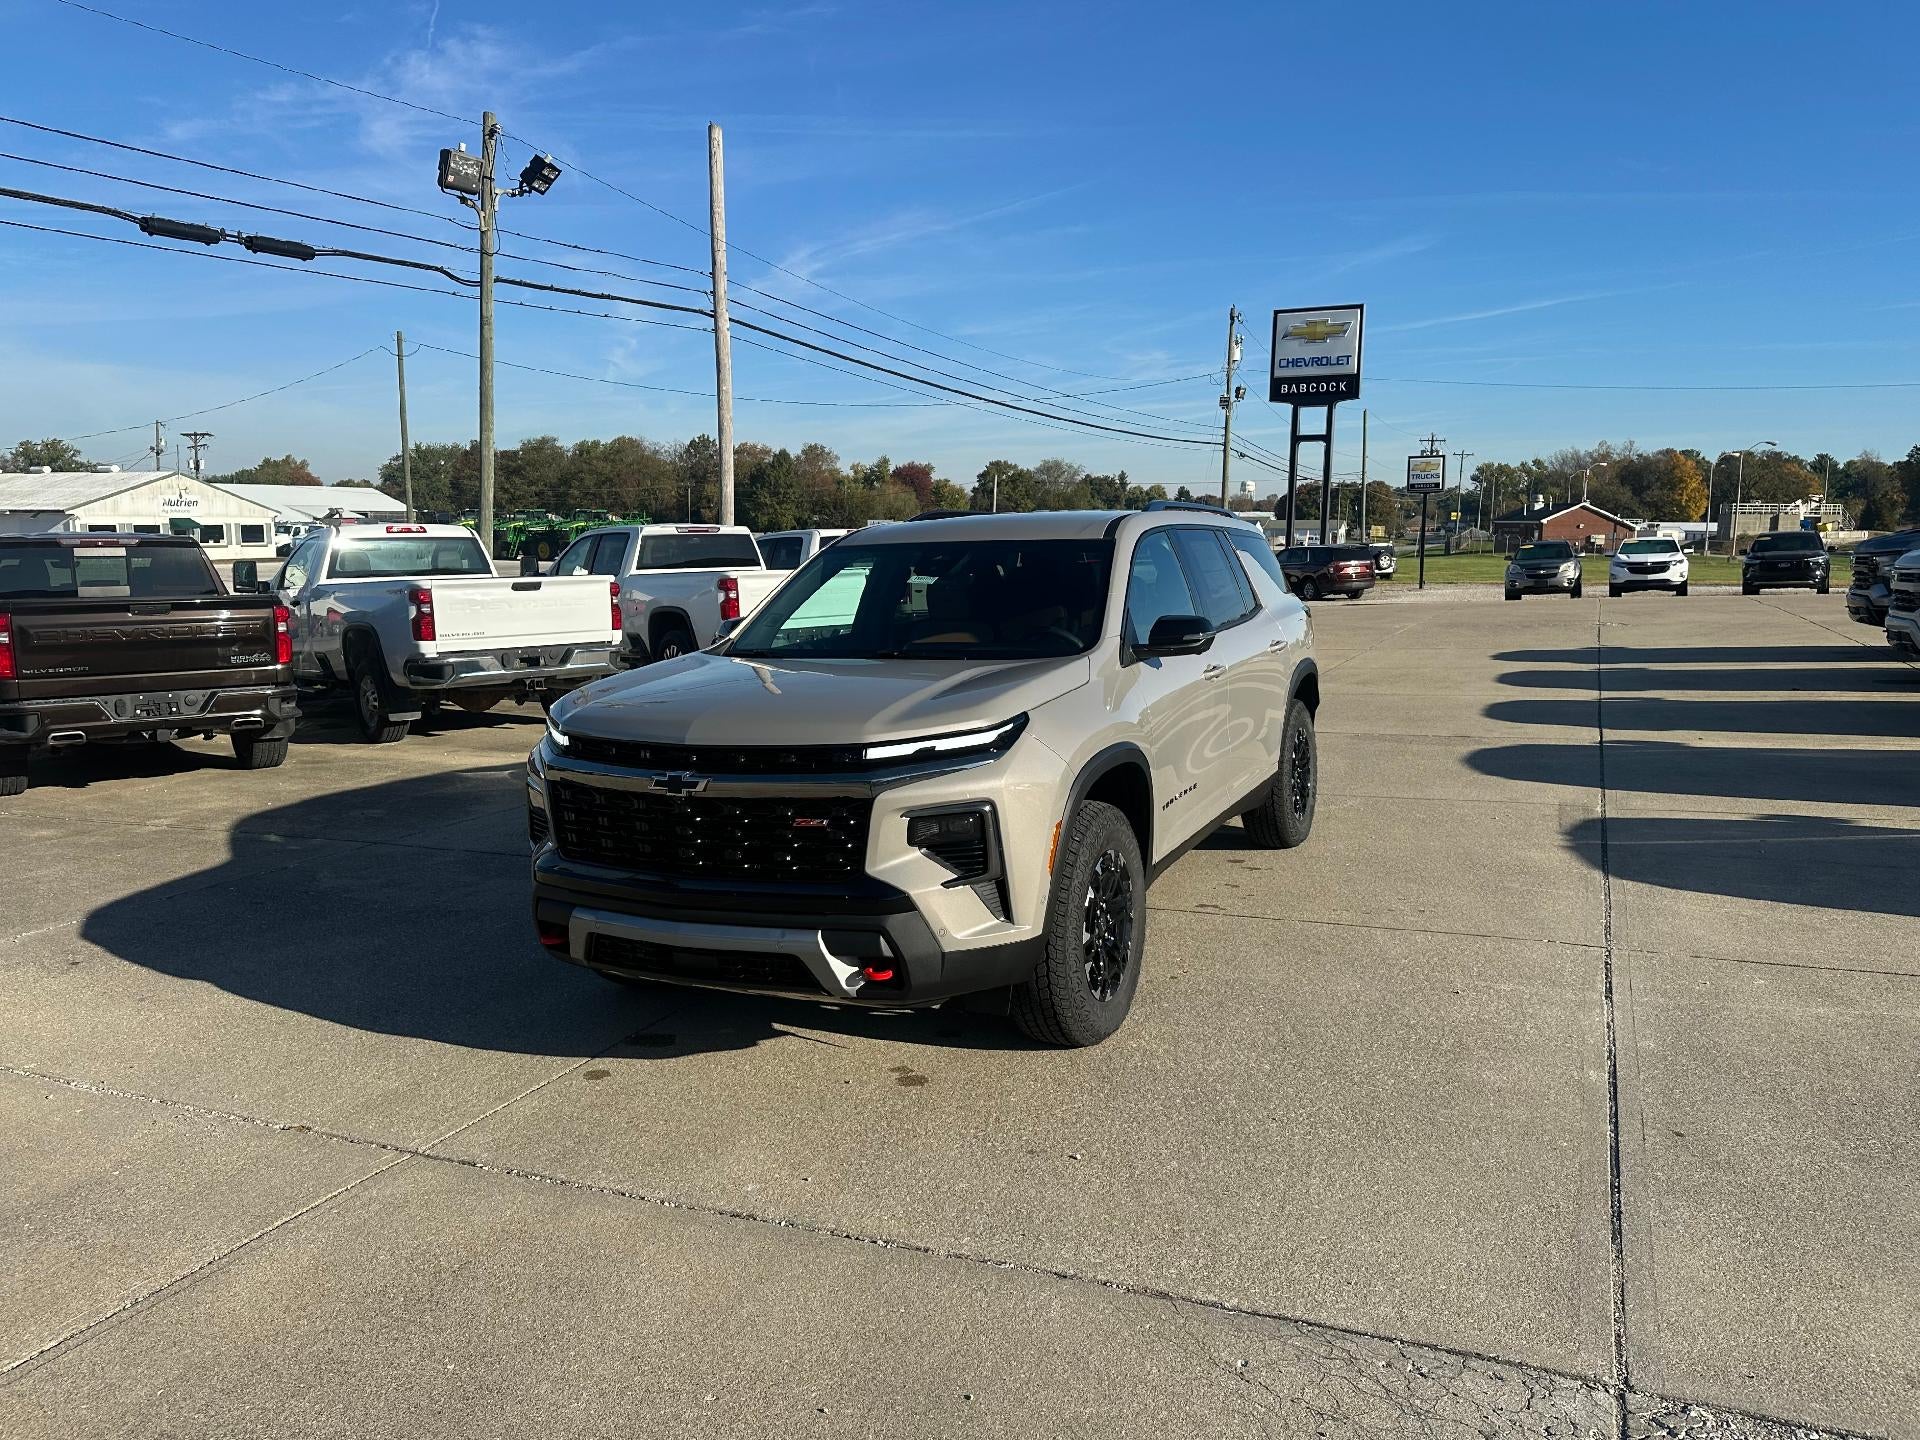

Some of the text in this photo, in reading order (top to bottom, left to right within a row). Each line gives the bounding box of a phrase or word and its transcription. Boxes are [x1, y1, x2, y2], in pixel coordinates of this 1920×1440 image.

[1279, 354, 1352, 369] CHEVROLET
[1280, 381, 1348, 394] BABCOCK
[1411, 472, 1441, 480] TRUCKS
[162, 497, 199, 507] Nutrien
[33, 623, 261, 643] CHEVROLET
[22, 666, 89, 674] SILVERADO
[1162, 782, 1198, 812] TRAVERSE
